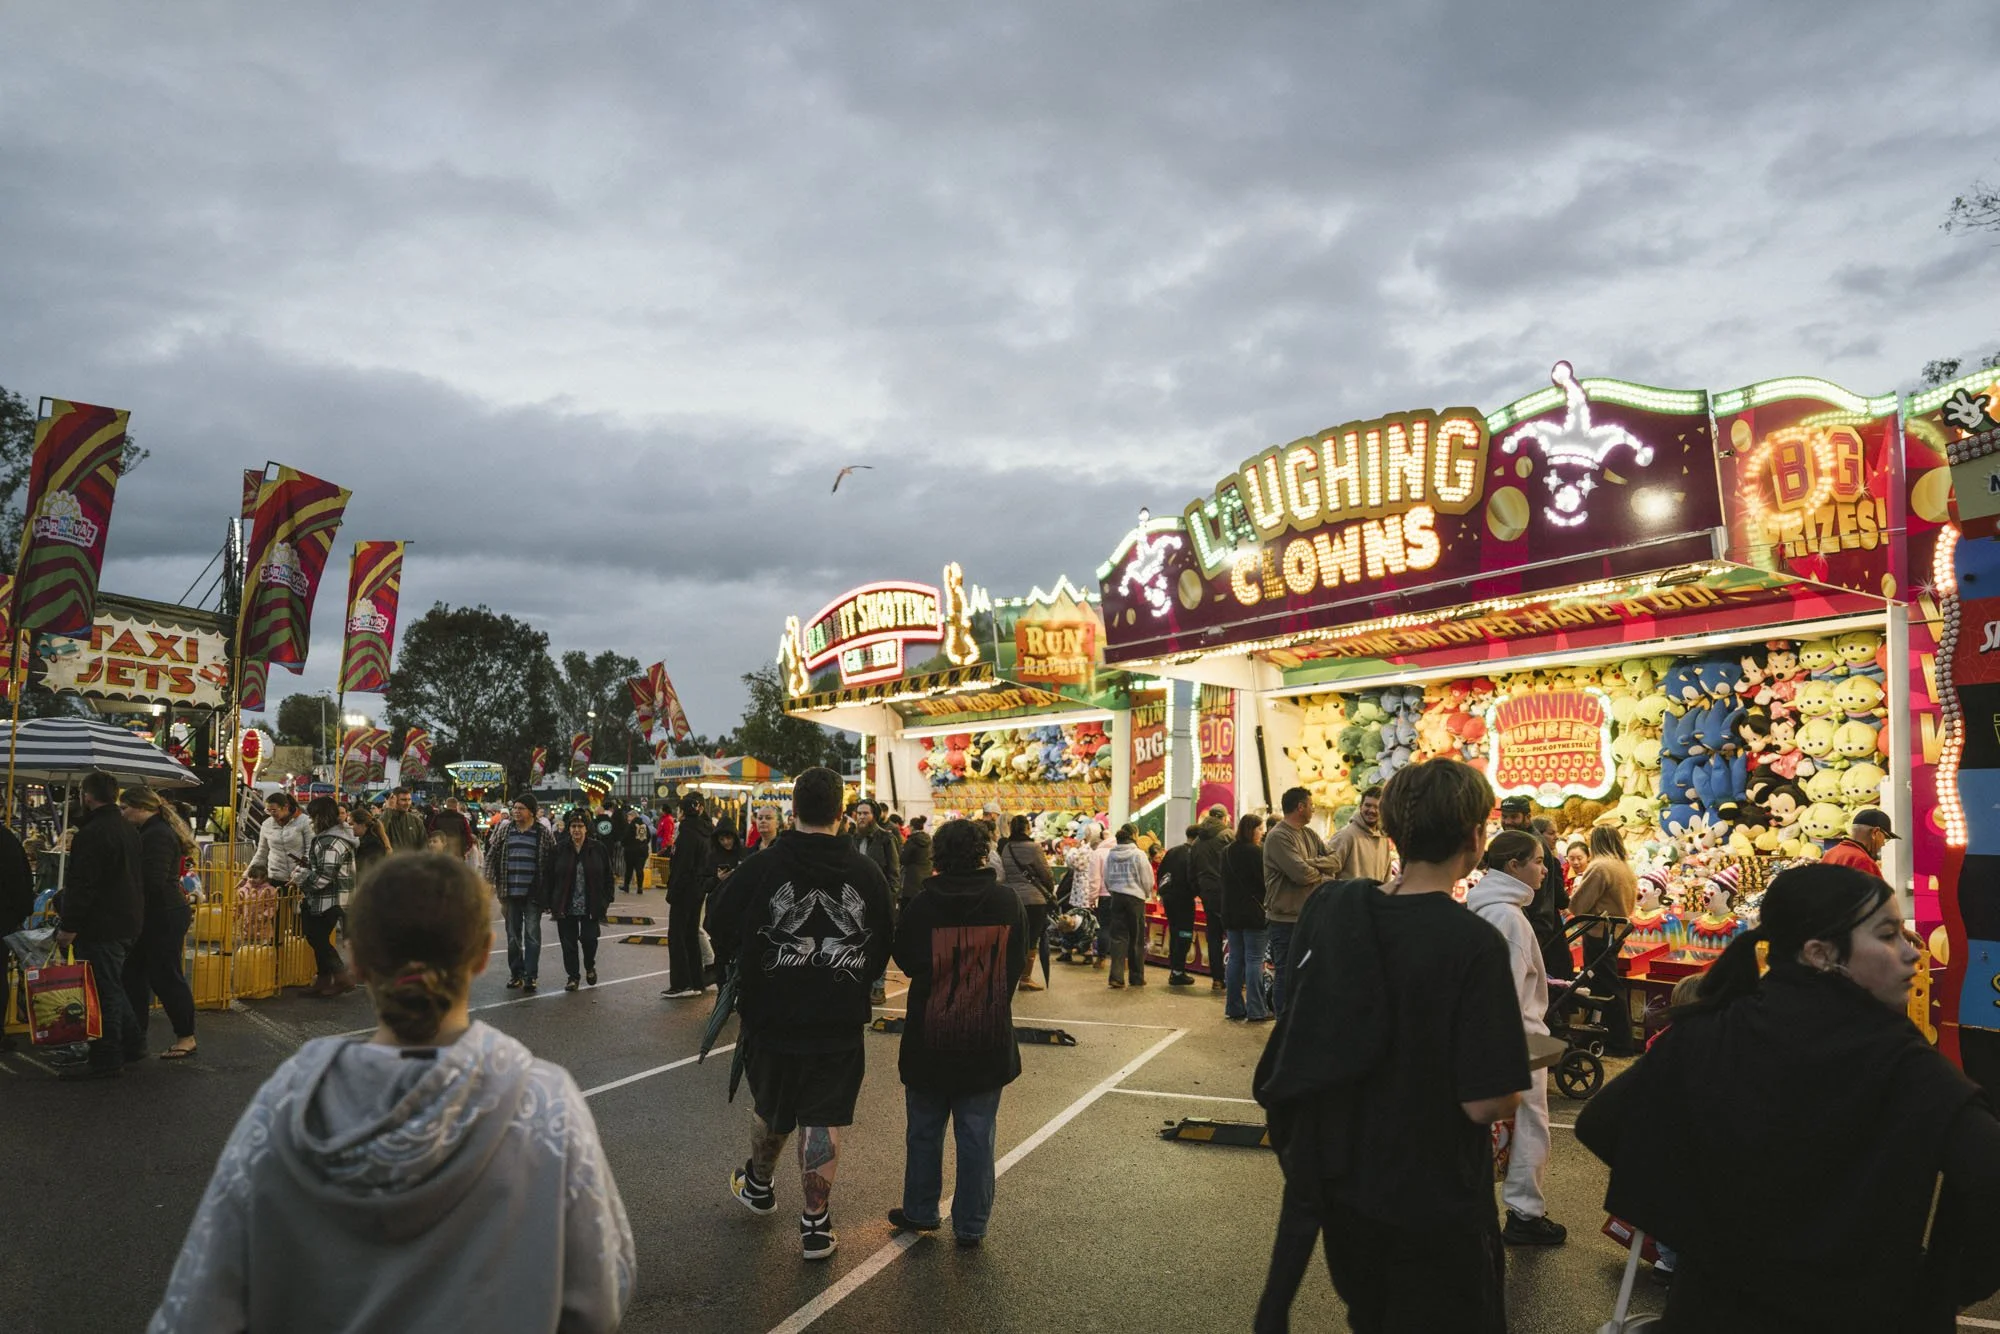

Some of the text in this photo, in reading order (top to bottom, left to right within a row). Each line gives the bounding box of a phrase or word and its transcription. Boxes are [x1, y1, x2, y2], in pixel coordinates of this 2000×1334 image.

[1187, 416, 1481, 571] LAUGHING
[1764, 498, 1890, 559] PRIZES!
[1230, 504, 1441, 606] CLOWNS
[857, 591, 937, 633] SHOOTING
[1333, 584, 1725, 658] COME ON OVER, HAVE A GO!
[90, 624, 199, 664] TAXI
[1024, 627, 1085, 655] RUN
[76, 656, 197, 694] JETS
[1023, 656, 1088, 676] RABBIT
[921, 697, 963, 716] RUN
[963, 689, 1026, 712] RABBIT
[1136, 700, 1165, 728] WIN
[1496, 691, 1601, 731] WINNING
[1134, 731, 1163, 765] BIG
[1200, 717, 1234, 759] BIG
[1500, 720, 1600, 747] NUMBERS
[459, 770, 502, 782] STORM
[1133, 771, 1165, 799] PRIZES
[1201, 763, 1233, 783] PRIZES
